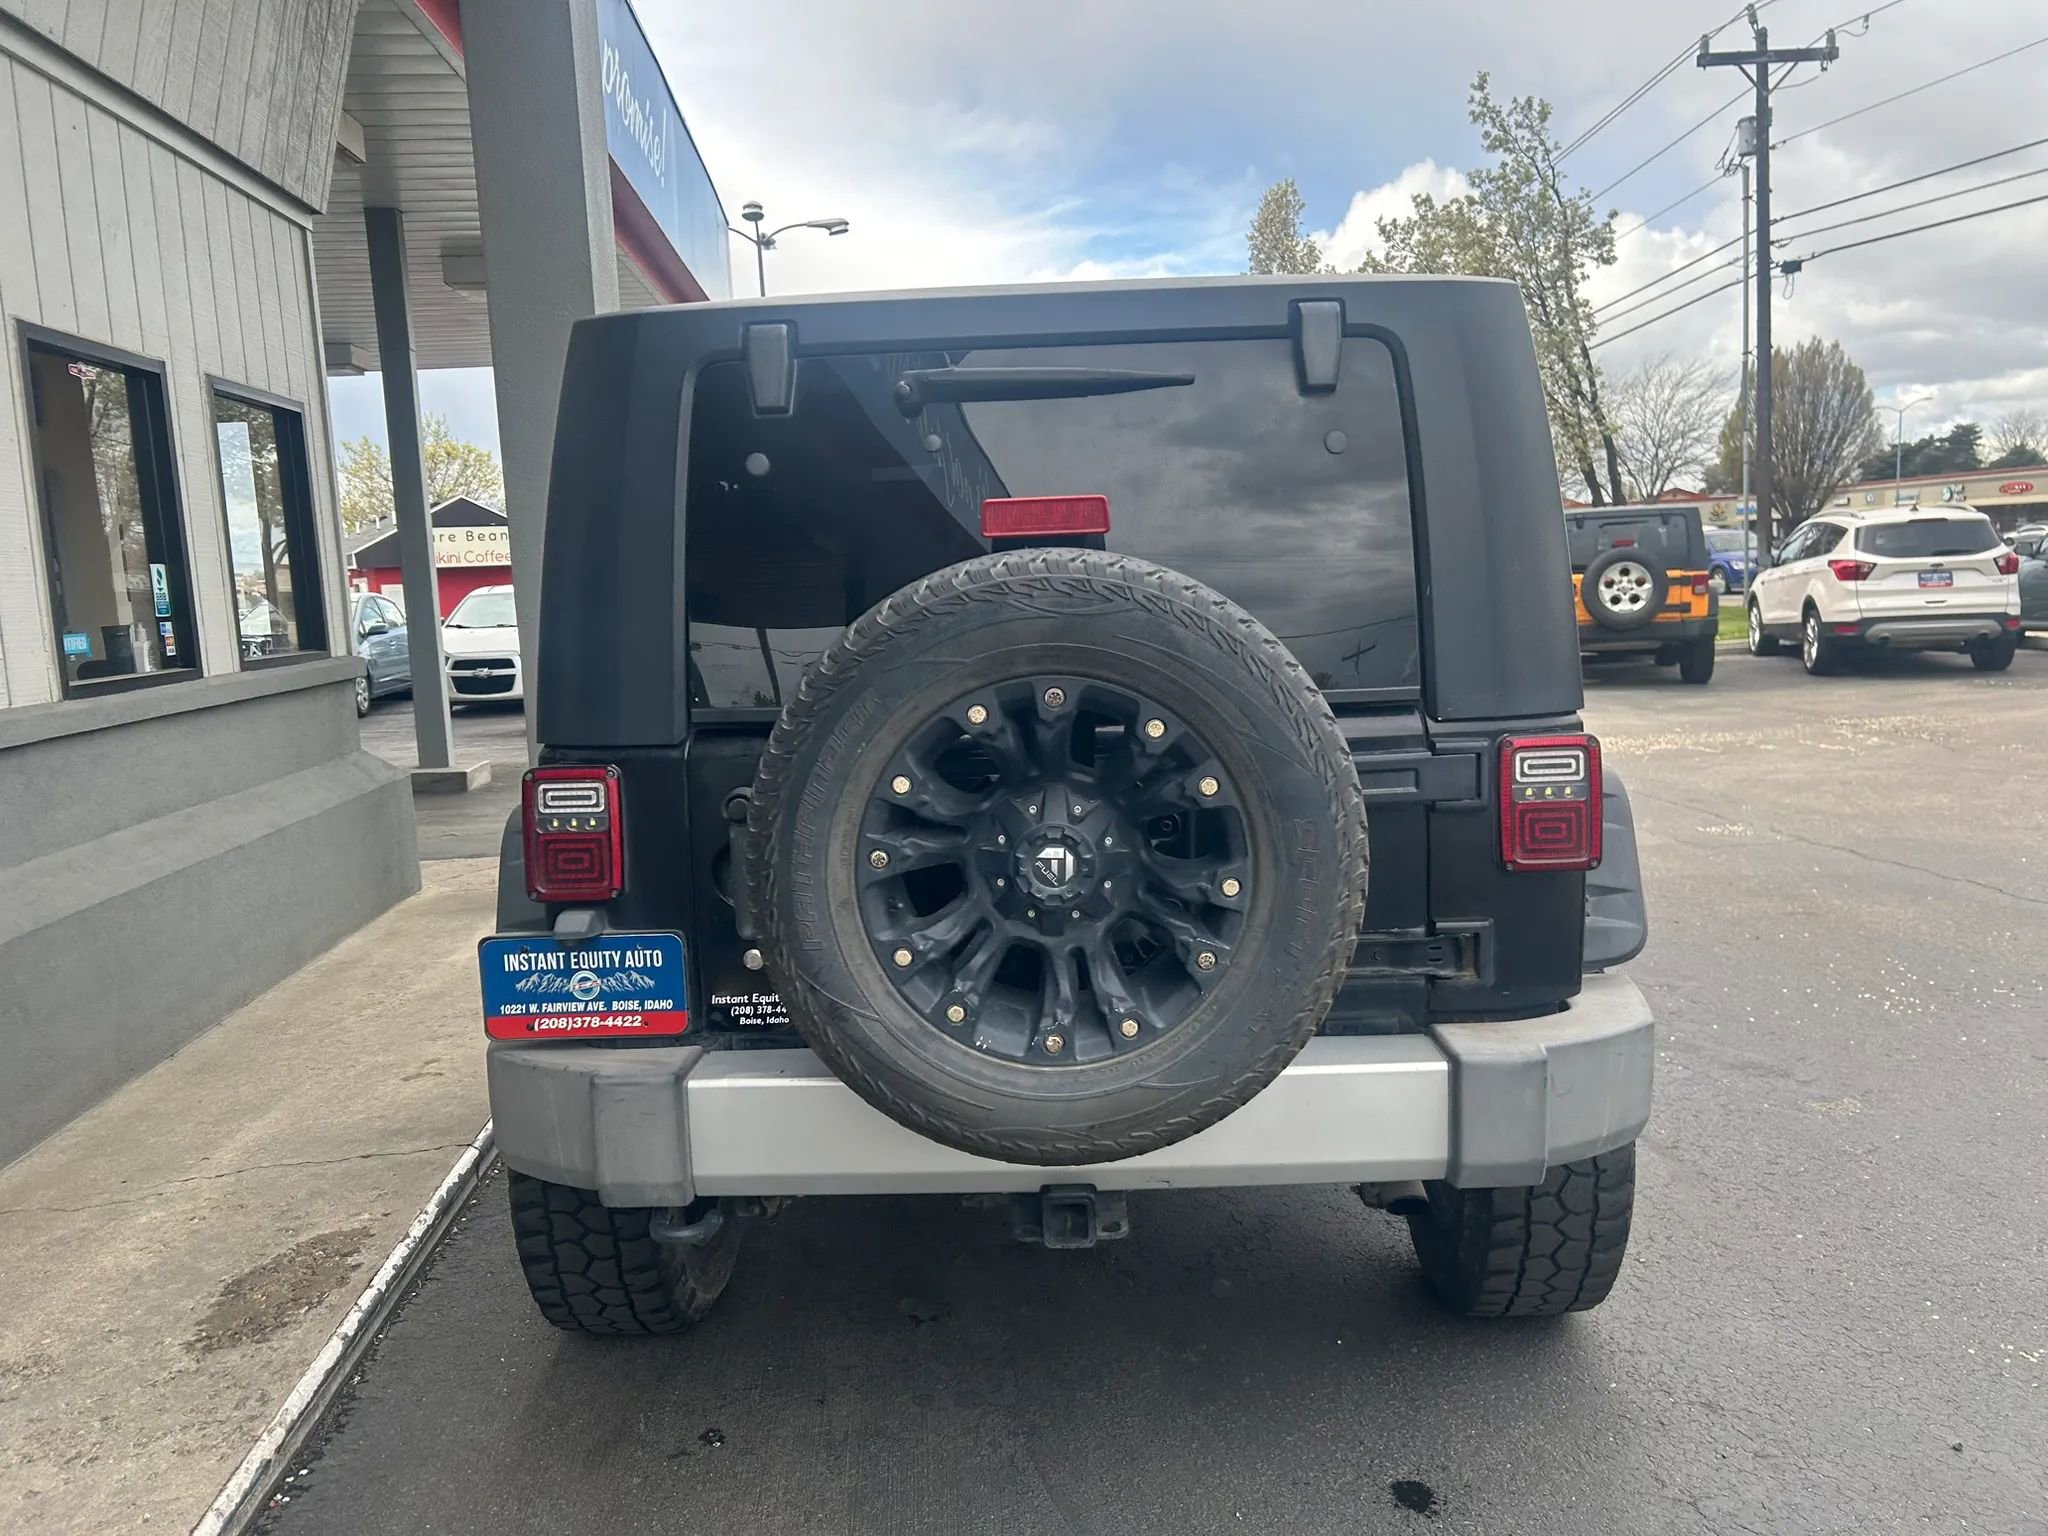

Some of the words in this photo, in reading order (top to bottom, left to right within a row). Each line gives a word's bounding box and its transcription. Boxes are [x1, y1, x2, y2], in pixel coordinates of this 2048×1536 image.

[601, 37, 666, 188] promise!
[464, 550, 511, 564] Coffee
[1035, 860, 1059, 886] FUEL
[503, 952, 566, 972] INSTANT
[570, 950, 622, 970] EQUITY
[624, 949, 663, 968] AUTO
[711, 994, 749, 1005] Instant
[752, 992, 783, 1005] Equit
[500, 1004, 526, 1015] 10221
[529, 1003, 539, 1013] W.
[541, 1001, 587, 1013] FAIRVIEW
[586, 1001, 607, 1012] AVE.
[611, 1000, 642, 1012] BOISE,
[644, 999, 673, 1011] IDAHO
[730, 1006, 754, 1017] (208)
[533, 1015, 643, 1032] (208)378-4422
[739, 1016, 764, 1026] Boise,
[766, 1015, 790, 1024] Idaho
